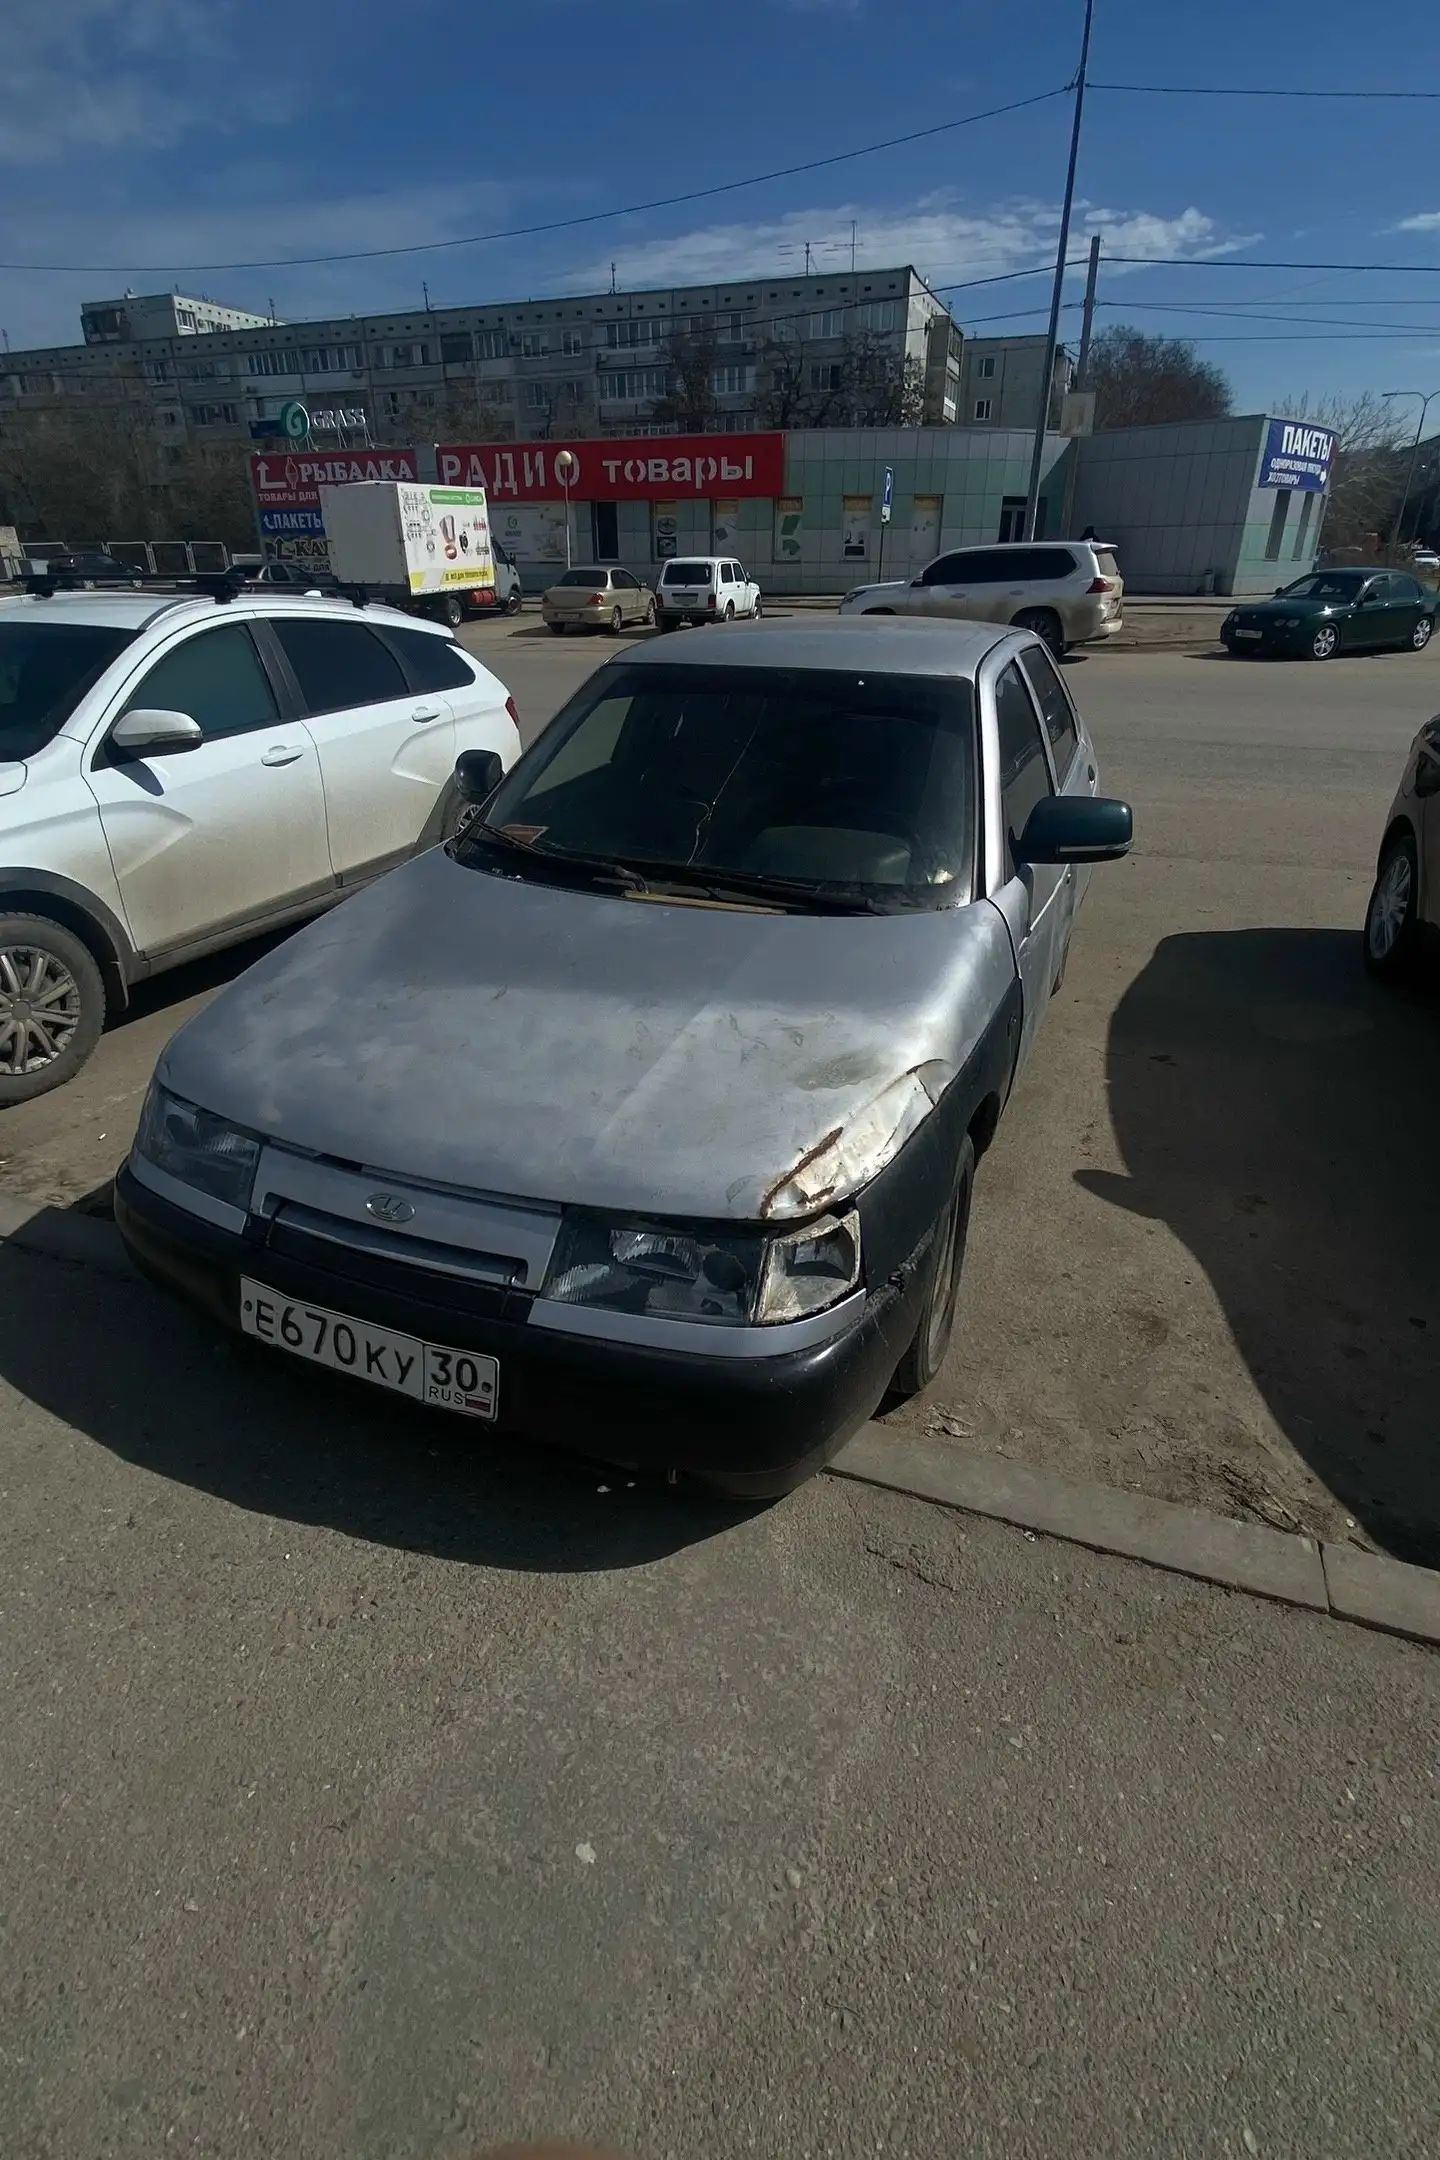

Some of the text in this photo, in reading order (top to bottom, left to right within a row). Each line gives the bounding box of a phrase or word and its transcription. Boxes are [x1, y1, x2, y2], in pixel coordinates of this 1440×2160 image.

[313, 408, 366, 429] GRASS
[1281, 426, 1333, 461] ПАКЕТЫ
[299, 458, 415, 483] РЫБАЛКА
[441, 450, 753, 496] РАДИО товары
[258, 491, 296, 502] ТОВАРЫ
[431, 1350, 478, 1392] 30
[428, 1386, 464, 1405] RUS
